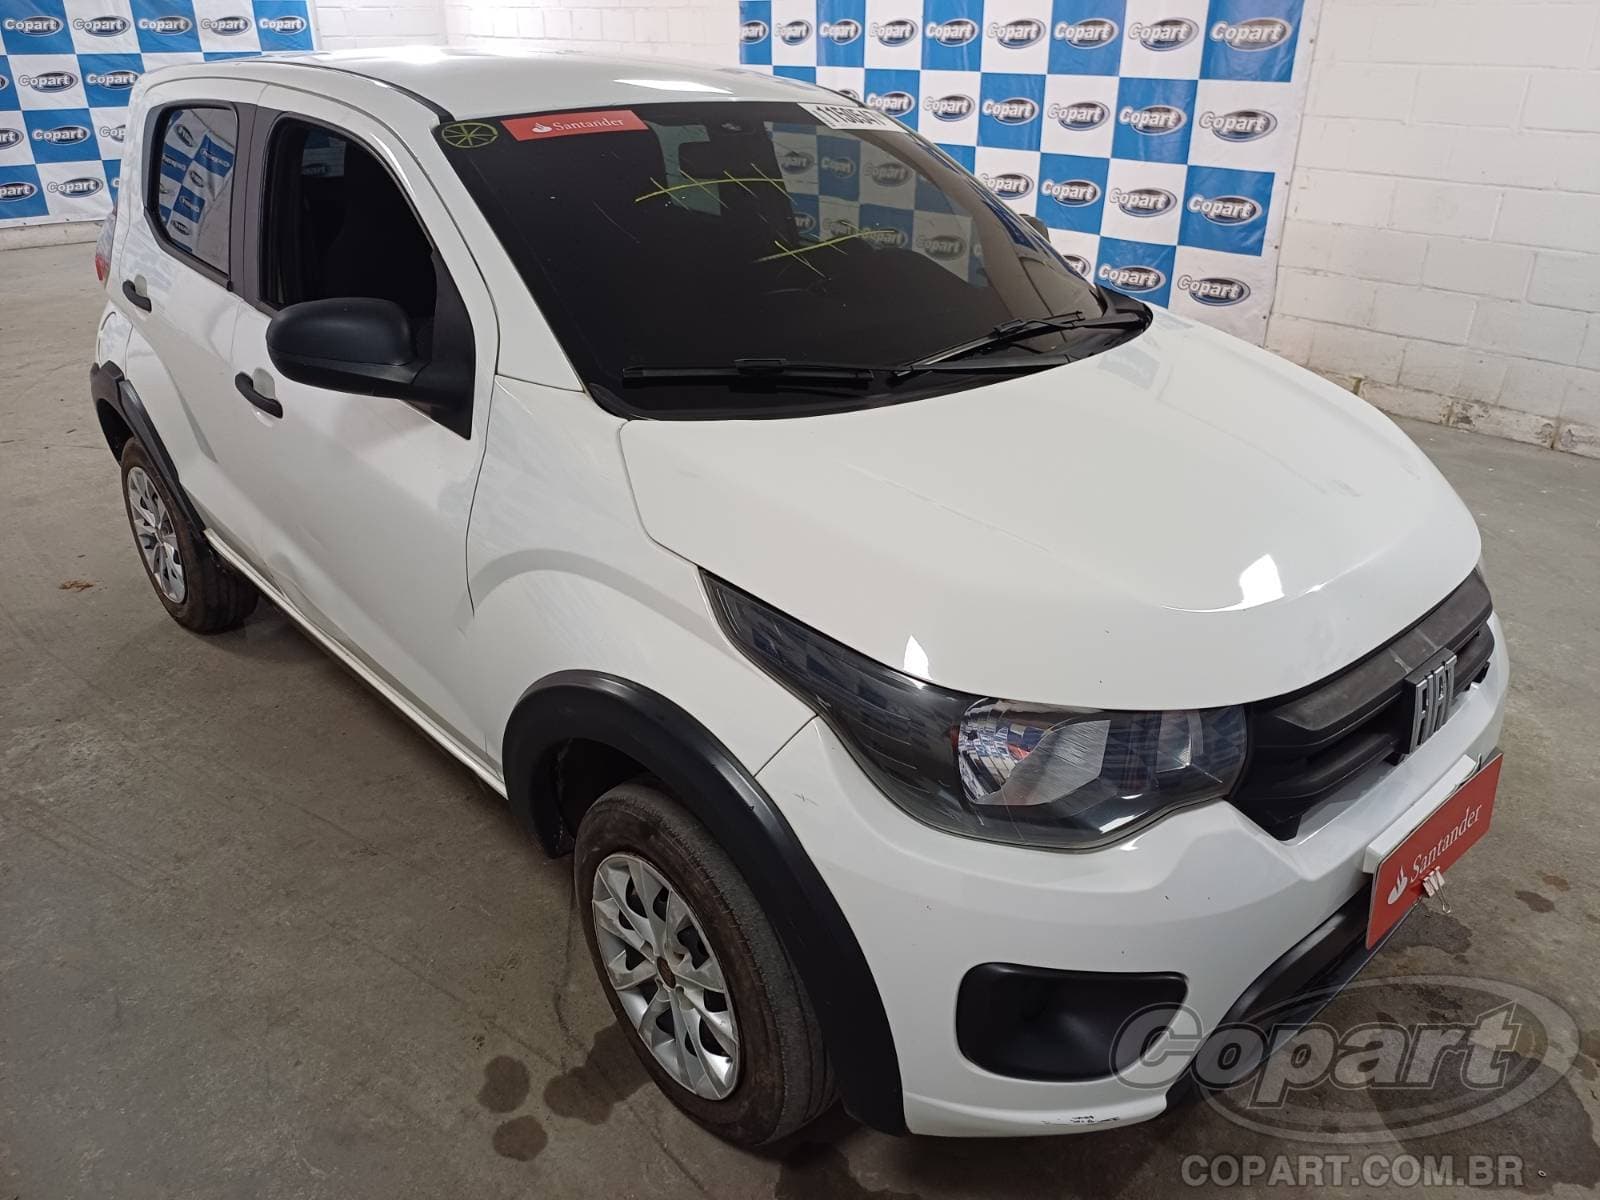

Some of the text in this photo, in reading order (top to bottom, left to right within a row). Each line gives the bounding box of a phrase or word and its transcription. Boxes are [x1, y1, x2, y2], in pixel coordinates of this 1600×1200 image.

[4, 19, 57, 32] Copart
[74, 18, 122, 32] Copart
[138, 18, 185, 31] Copart
[201, 18, 245, 30] Copart
[259, 17, 302, 30] Copart
[741, 23, 765, 38] part
[775, 22, 807, 39] Copart
[820, 23, 856, 39] Copart
[869, 22, 911, 40] Copart
[925, 22, 971, 41] Copart
[988, 22, 1037, 42] Copart
[1054, 21, 1112, 42] Copart
[1128, 22, 1188, 43] Copart
[1210, 21, 1283, 45] Copart
[19, 74, 70, 88] Copart
[87, 73, 136, 87] Copart
[866, 93, 909, 110] Copart
[924, 96, 971, 114] Copart
[983, 98, 1034, 119] Copart
[1048, 103, 1101, 123] Copart
[1119, 106, 1177, 128] Copart
[1200, 111, 1265, 133] Copart
[100, 126, 126, 139] Cop
[552, 117, 625, 131] Santander
[32, 128, 83, 141] Copart
[0, 184, 30, 199] part
[48, 180, 96, 194] Copart
[1042, 178, 1096, 201] Copart
[1109, 188, 1167, 210] Copart
[1188, 194, 1253, 220] Copart
[1099, 264, 1157, 287] Copart
[1178, 275, 1240, 299] Copart
[1410, 804, 1482, 883] Santander
